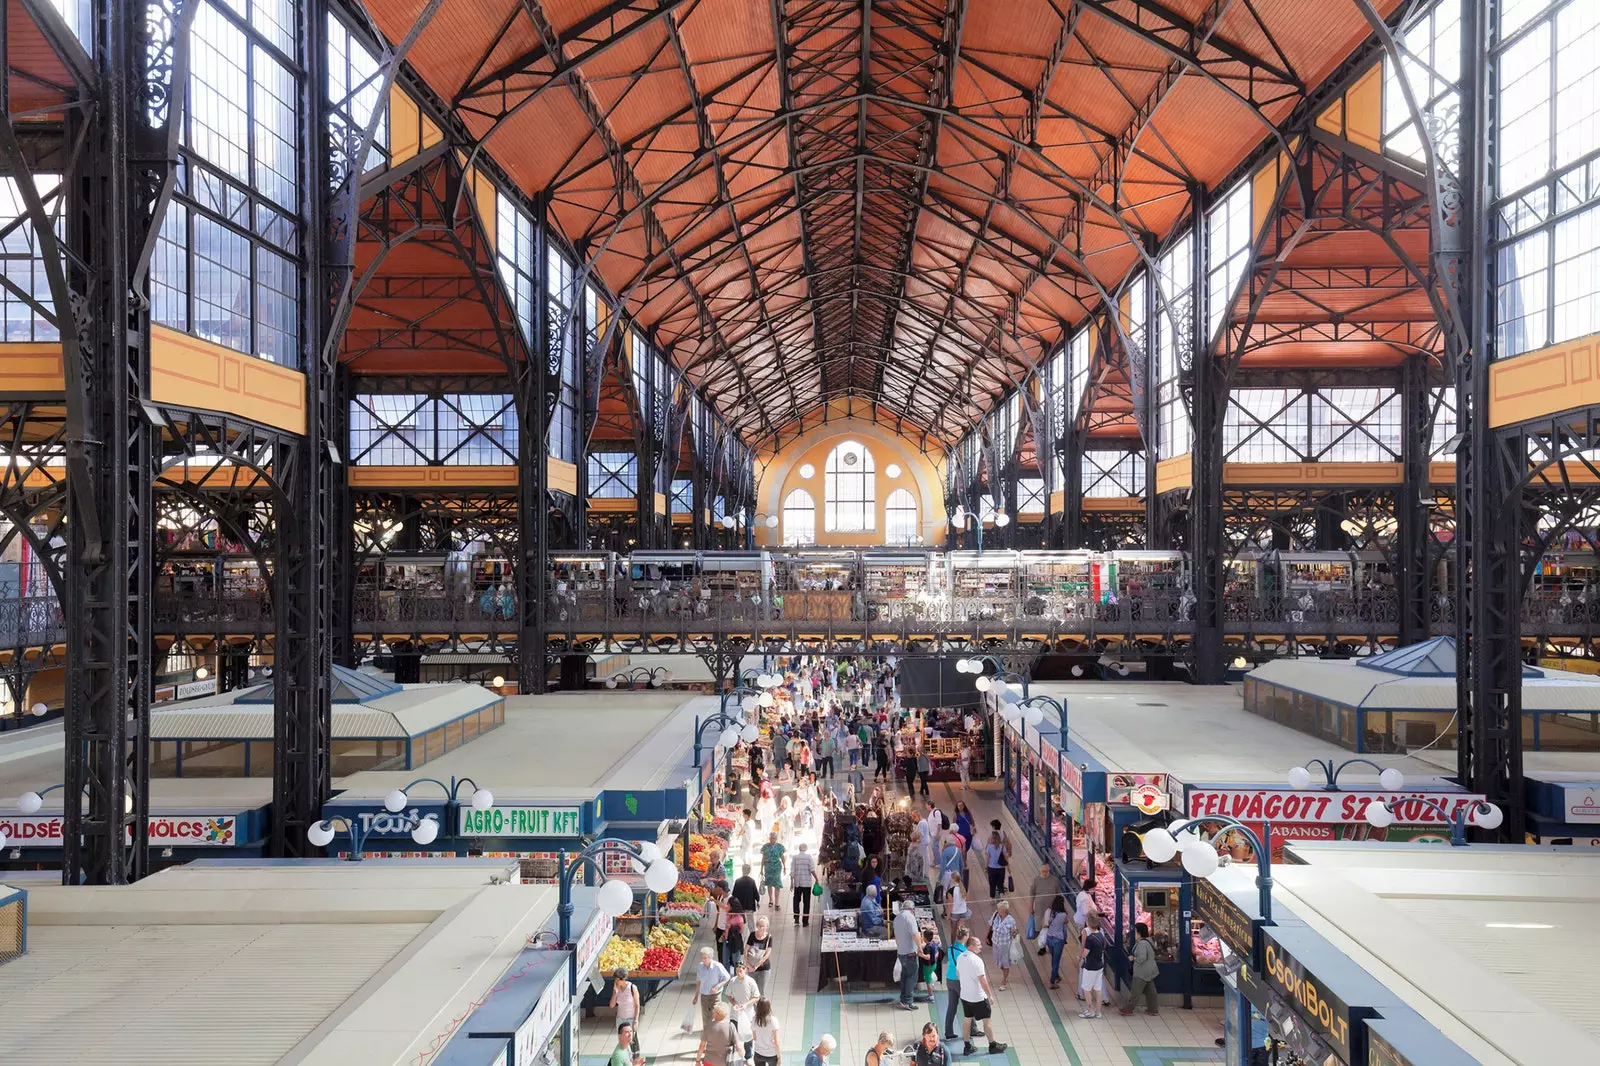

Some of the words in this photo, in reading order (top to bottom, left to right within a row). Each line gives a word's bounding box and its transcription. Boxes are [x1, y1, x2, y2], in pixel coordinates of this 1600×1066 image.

[1191, 792, 1332, 820] FELVÁGOTT
[1341, 793, 1484, 822] SZKÜZLE
[0, 818, 64, 839] ÖLDSÉ
[464, 809, 549, 834] AGRO-FRUIT
[1263, 827, 1330, 837] ABANOS
